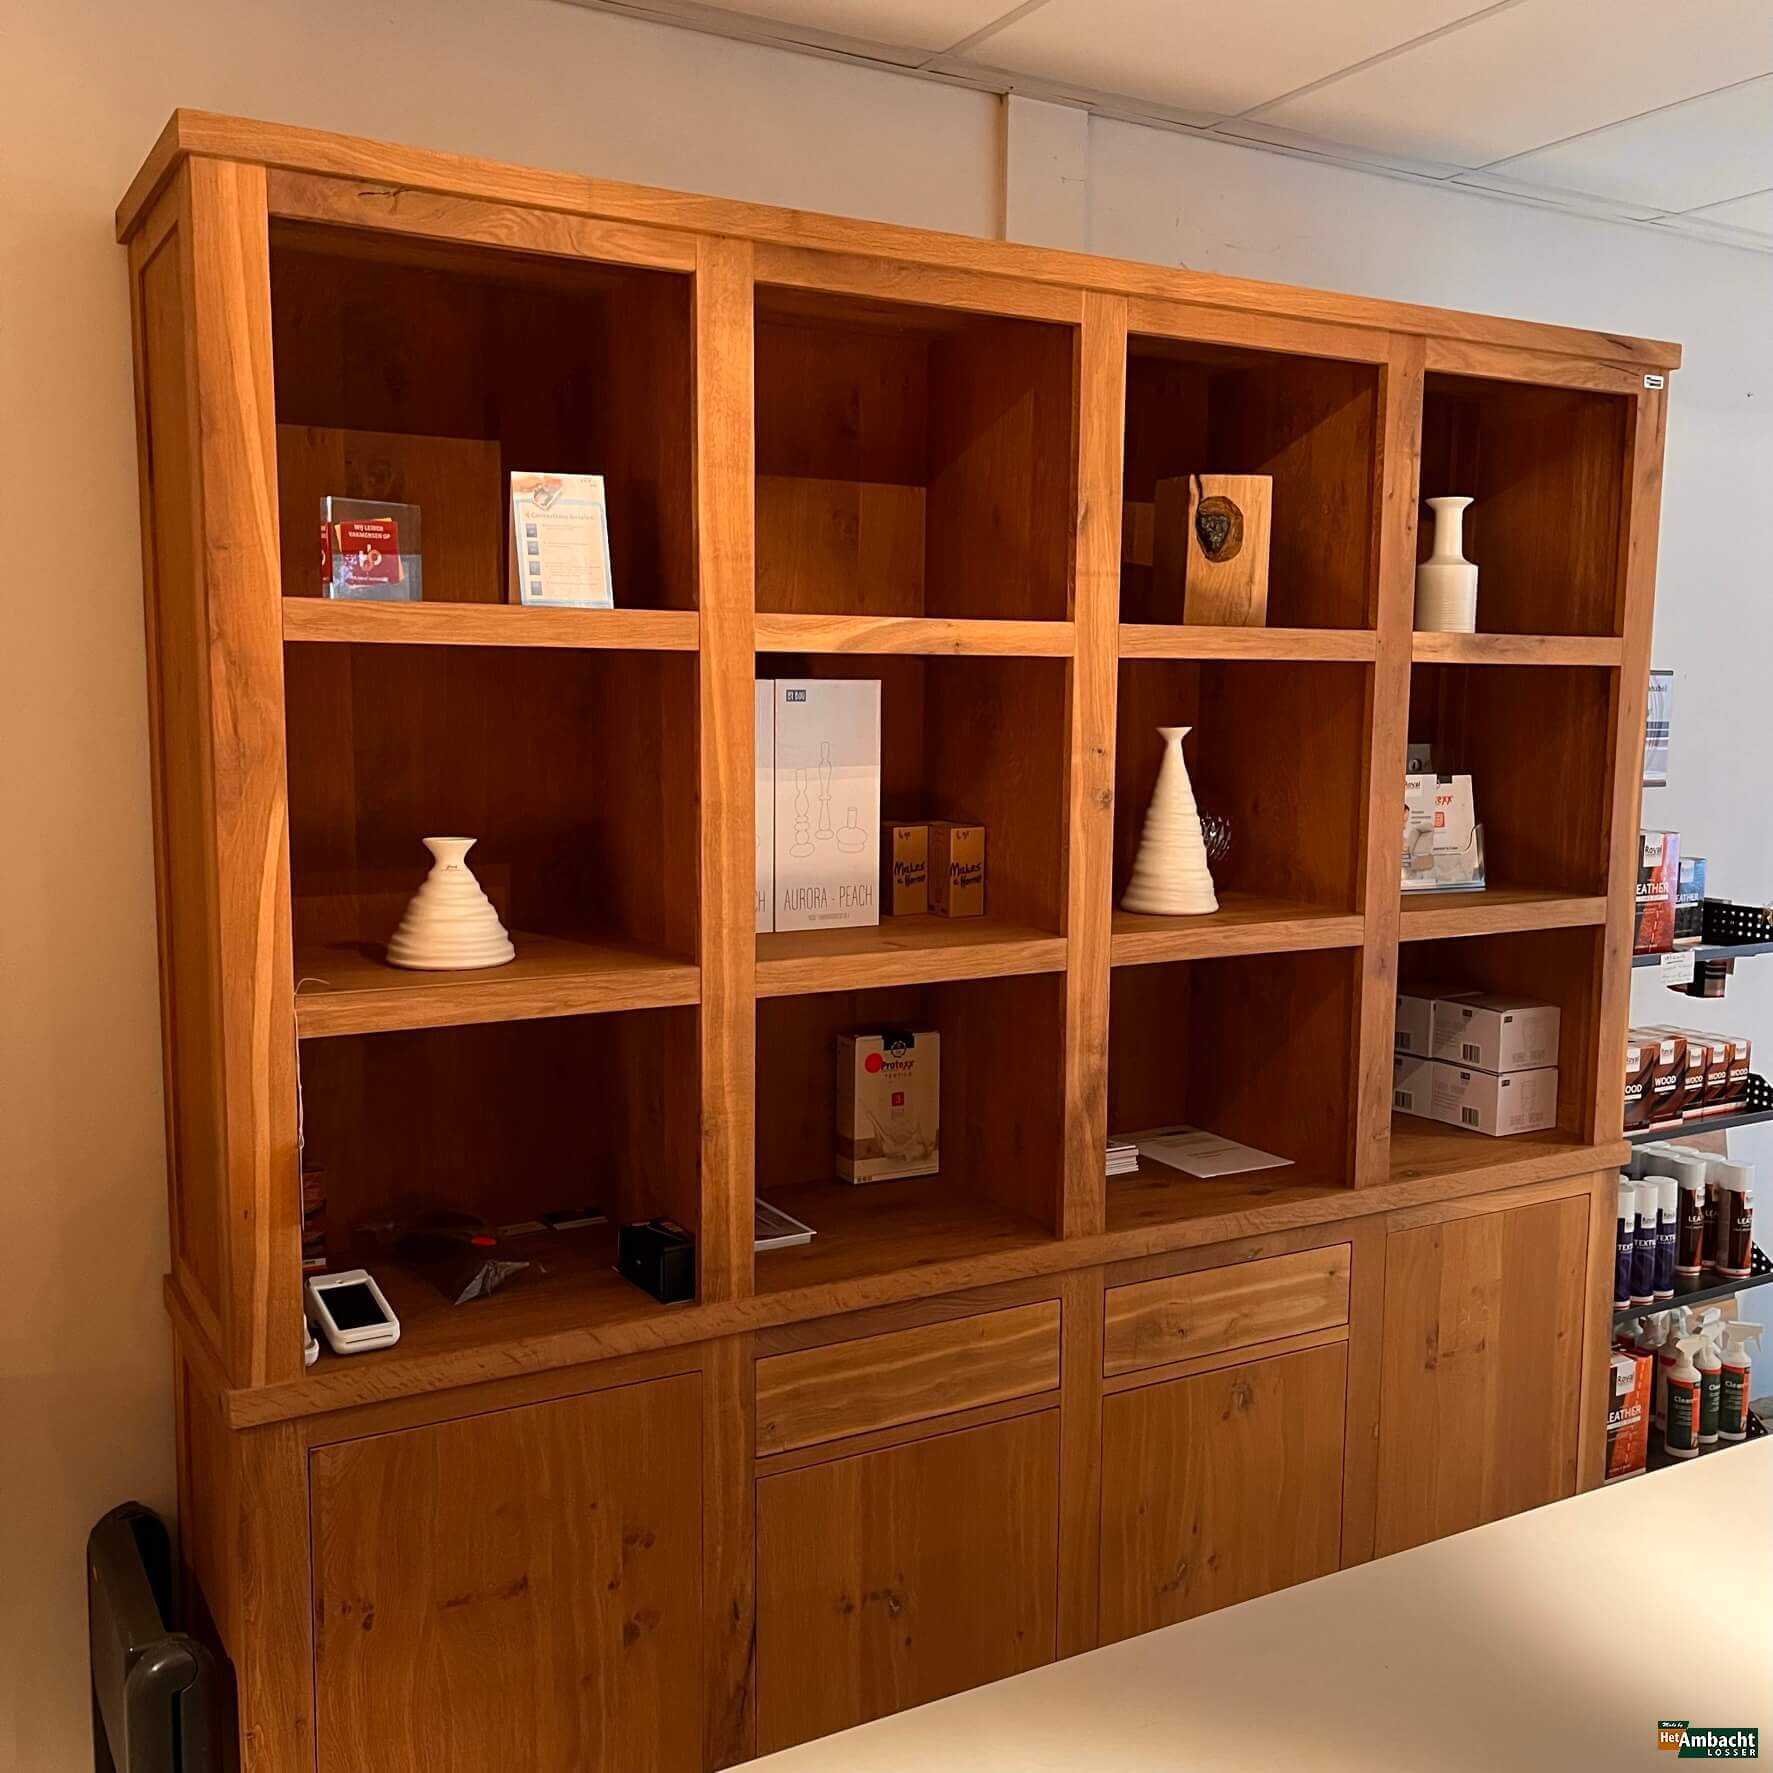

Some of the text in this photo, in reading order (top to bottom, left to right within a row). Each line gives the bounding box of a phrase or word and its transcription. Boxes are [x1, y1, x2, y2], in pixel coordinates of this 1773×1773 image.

[1636, 881, 1669, 895] EATHER
[784, 887, 828, 911] AURORA
[839, 884, 873, 908] PEACH
[1708, 1071, 1726, 1081] WOOD
[1730, 1067, 1748, 1077] WOOD
[1655, 1075, 1677, 1086] WOOD
[1685, 1075, 1704, 1085] WOOD
[1625, 1084, 1642, 1094] OOD
